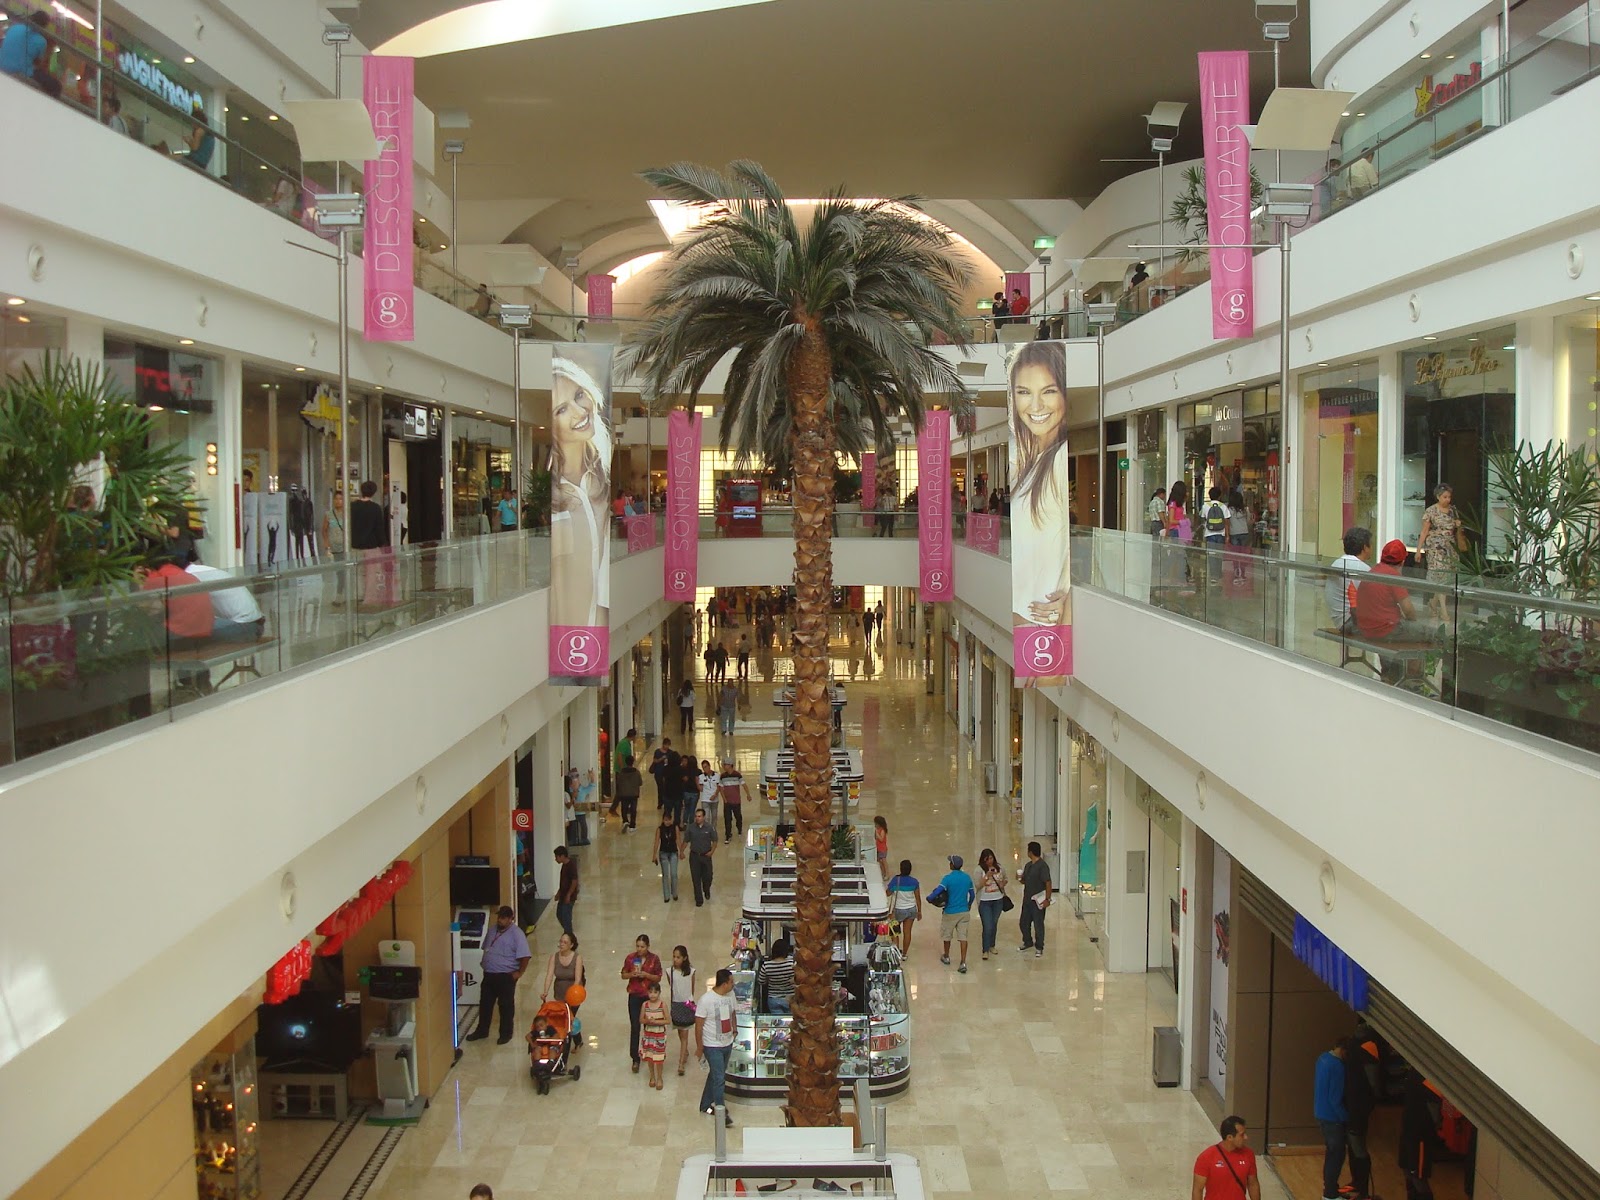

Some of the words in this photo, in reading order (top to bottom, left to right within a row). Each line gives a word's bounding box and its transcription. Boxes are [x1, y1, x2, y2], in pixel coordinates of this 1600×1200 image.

[374, 86, 400, 272] DESCUBRE
[1213, 79, 1247, 273] COMPARTE
[379, 296, 397, 323] g
[673, 436, 693, 551] SONRISAS
[926, 415, 943, 561] INSEPARABLES
[568, 635, 590, 667] g
[1033, 635, 1055, 668] g
